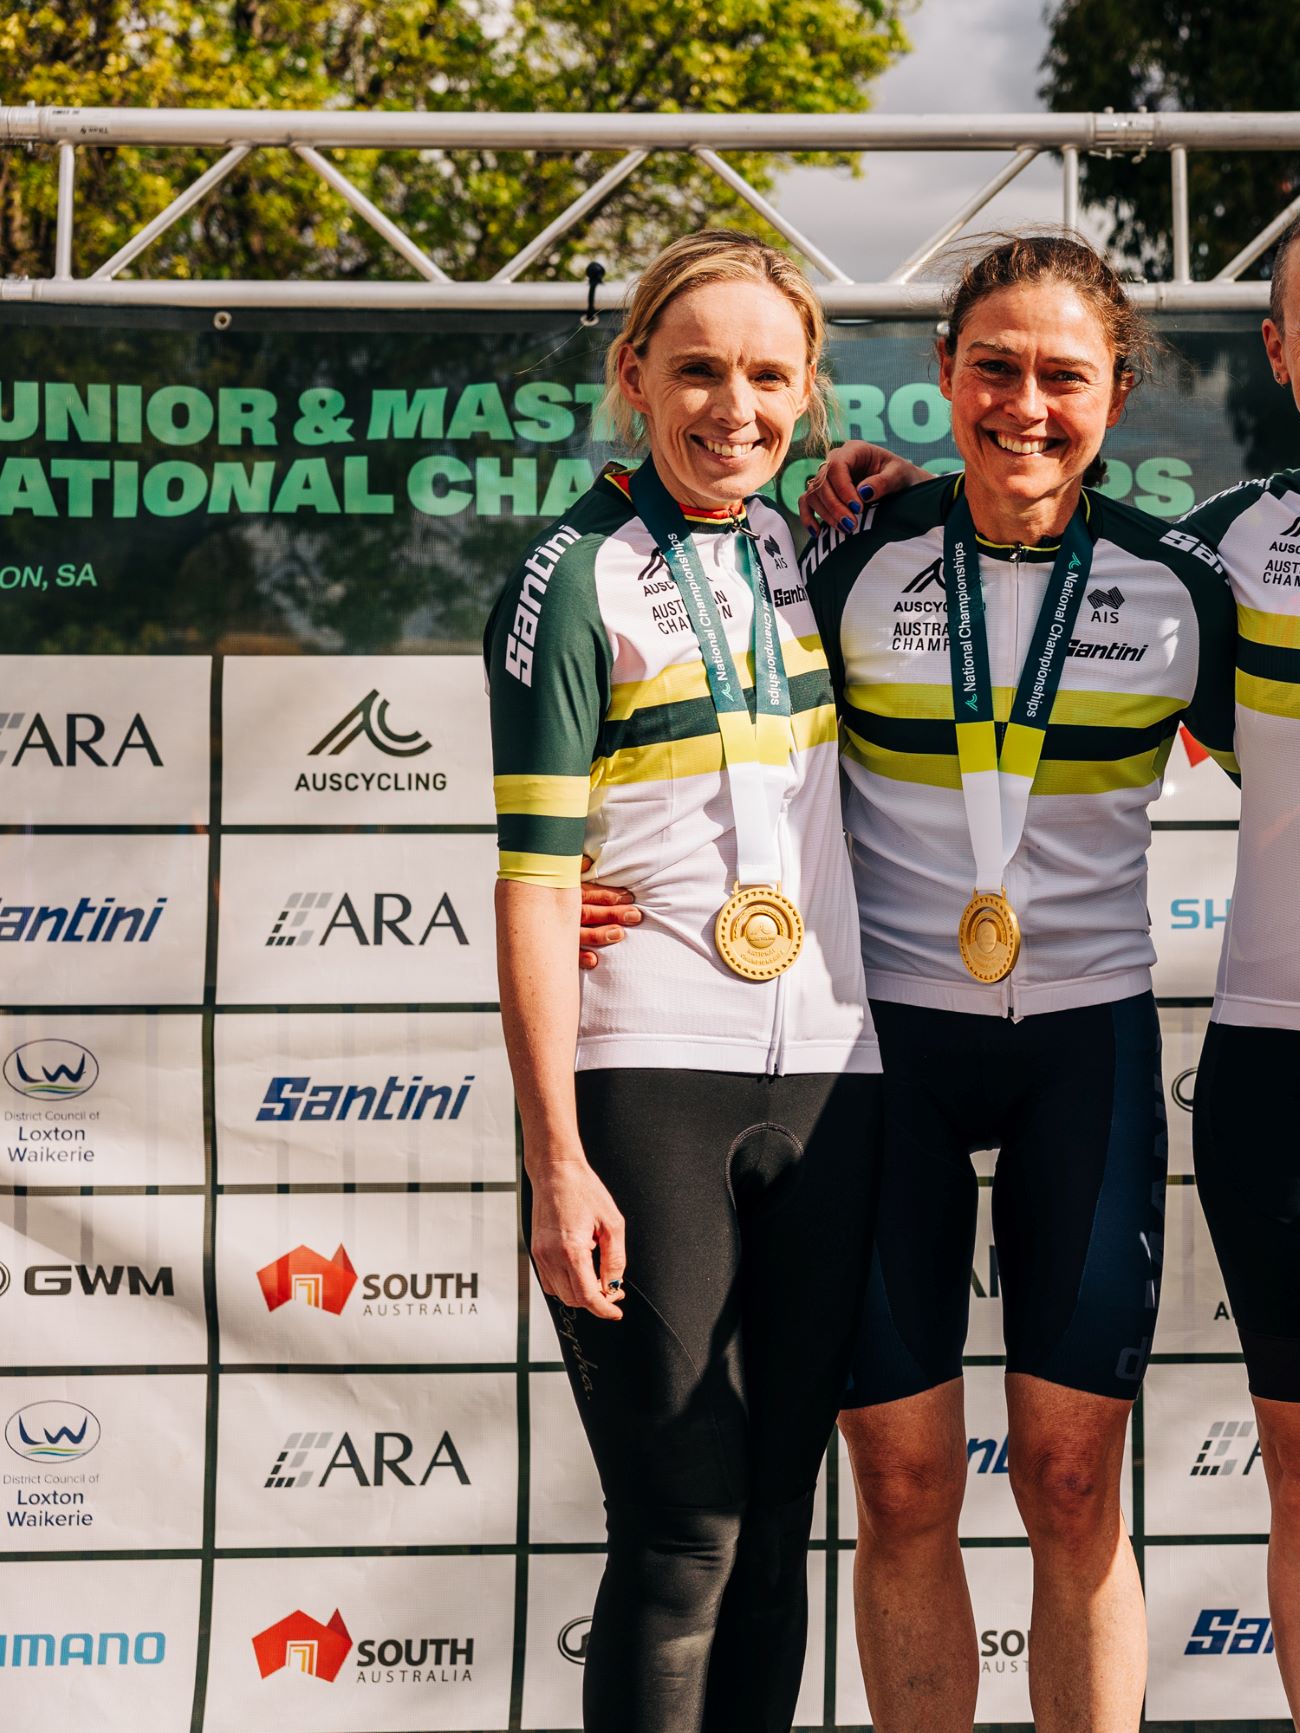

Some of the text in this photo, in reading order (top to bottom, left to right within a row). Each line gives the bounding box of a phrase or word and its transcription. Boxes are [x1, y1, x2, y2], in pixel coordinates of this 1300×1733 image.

[294, 387, 354, 445] &
[0, 456, 394, 518] ATIONAL
[56, 563, 97, 587] SA
[774, 557, 788, 569] AIS
[505, 524, 583, 688] Santini
[668, 533, 728, 681] National Championships
[954, 541, 976, 692] National Championships
[1091, 611, 1119, 624] AIS
[893, 622, 949, 637] AUSTRA
[892, 638, 950, 651] CHAMP
[1026, 571, 1079, 718] National Championships
[763, 614, 780, 705] Championships
[12, 713, 164, 767] ARA
[295, 773, 447, 791] AUSCYCLING
[319, 892, 470, 946] ARA
[256, 1075, 475, 1121] Santini
[4, 1111, 100, 1121] District Council of
[19, 1126, 86, 1141] Loxton
[8, 1146, 95, 1162] Waikerie
[24, 1265, 174, 1296] GWM
[363, 1273, 478, 1300] SOUTH
[363, 1303, 478, 1316] AUSTRALIA
[319, 1431, 471, 1487] ARA
[3, 1474, 100, 1485] District Council of
[17, 1490, 84, 1505] Loxton
[7, 1510, 93, 1527] Waikerie
[357, 1638, 473, 1667] SOUTH
[357, 1670, 472, 1683] AUSTRALIA
